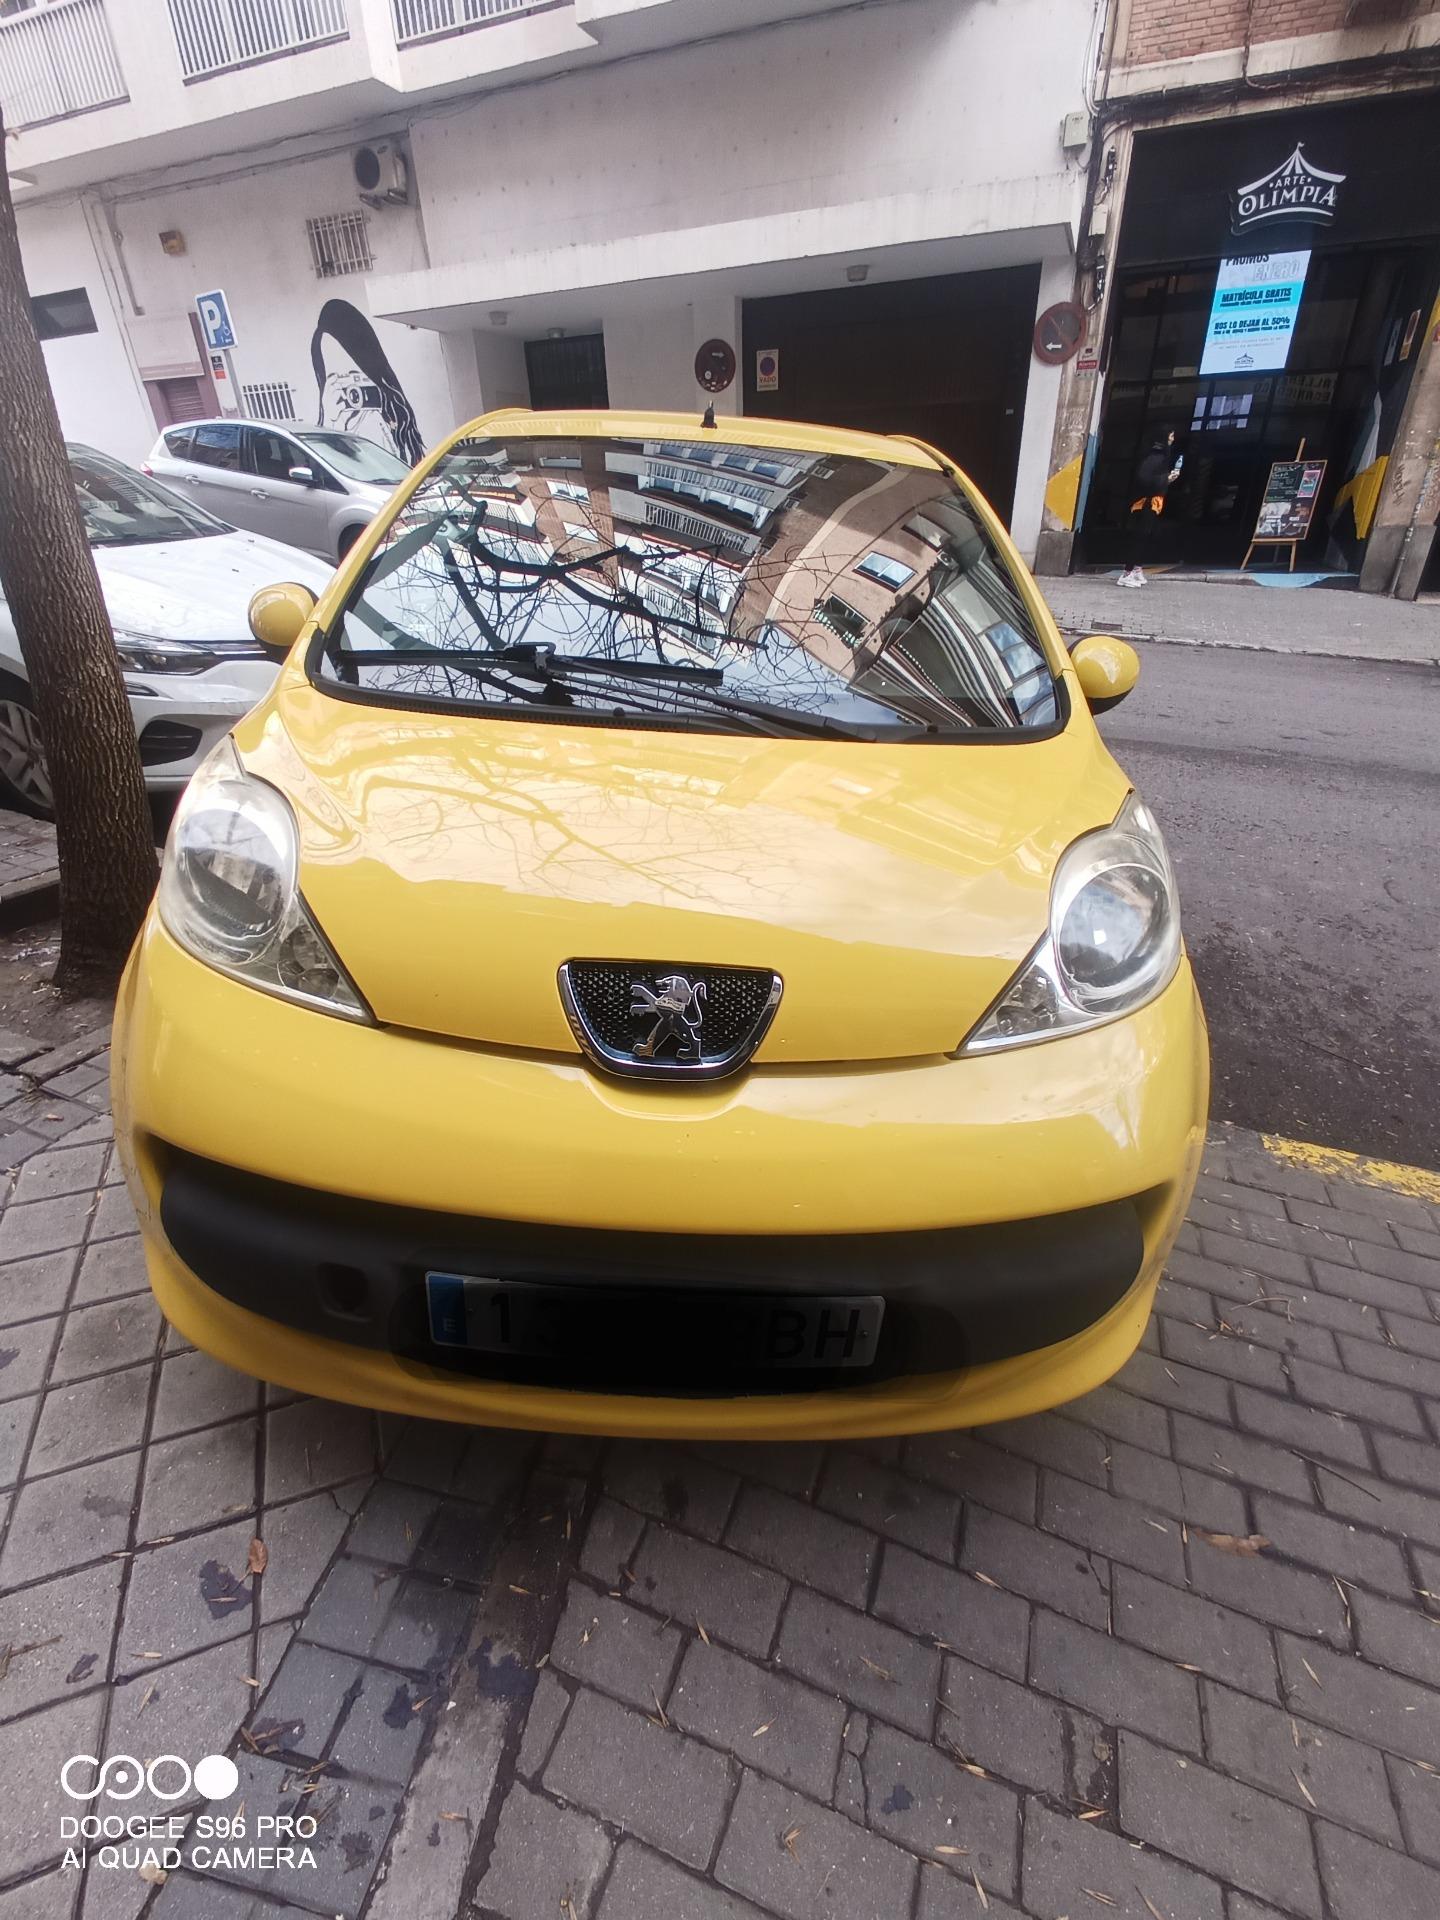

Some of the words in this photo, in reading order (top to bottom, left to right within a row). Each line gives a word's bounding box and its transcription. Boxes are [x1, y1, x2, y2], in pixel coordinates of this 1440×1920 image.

[1275, 175, 1306, 188] ARTE
[1238, 184, 1336, 215] OLIMPIA
[1221, 289, 1264, 302] MATRÍCULA
[1265, 288, 1292, 299] GRATIS
[201, 300, 221, 344] P
[1261, 318, 1269, 326] AL
[1271, 316, 1290, 325] 50%
